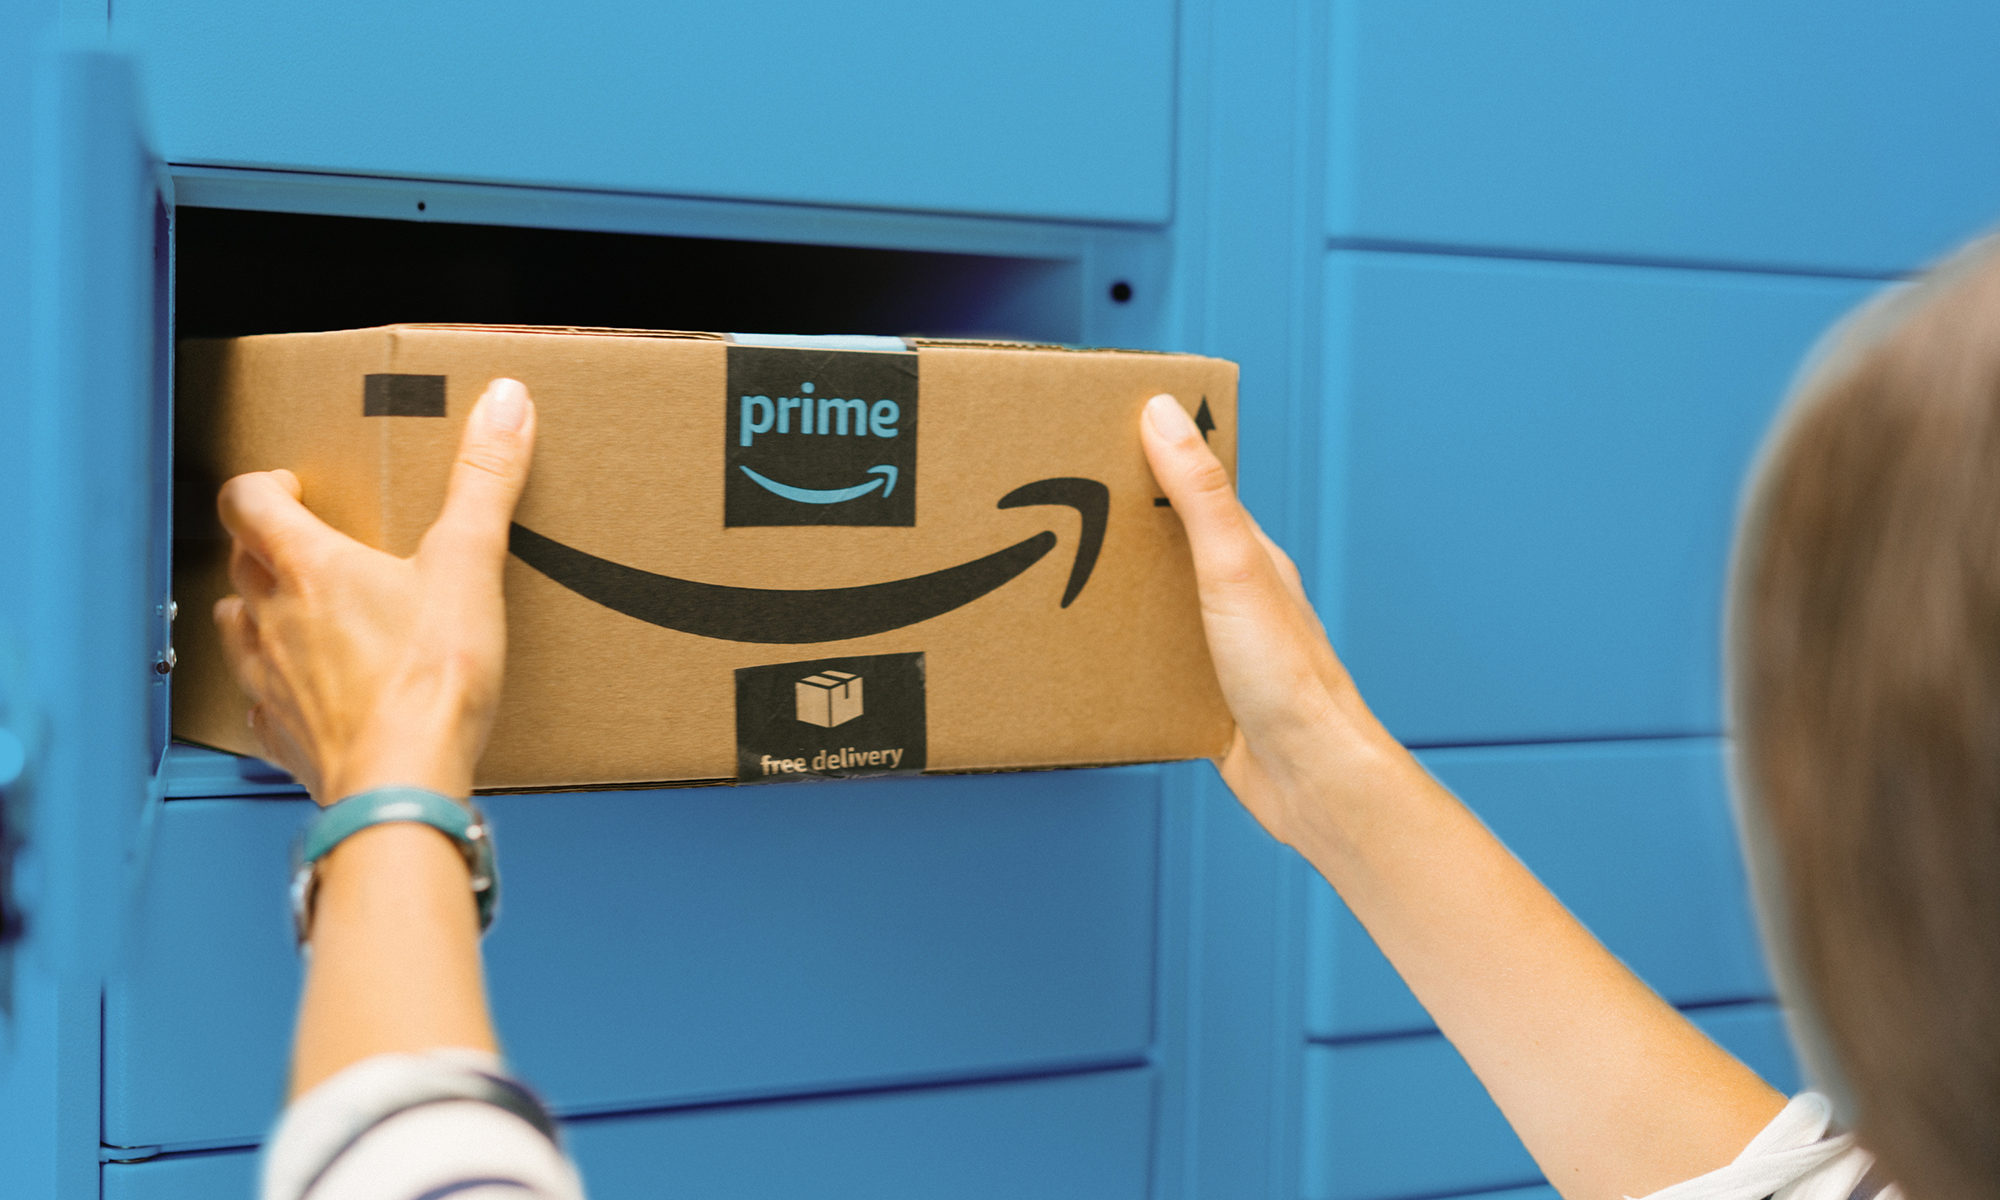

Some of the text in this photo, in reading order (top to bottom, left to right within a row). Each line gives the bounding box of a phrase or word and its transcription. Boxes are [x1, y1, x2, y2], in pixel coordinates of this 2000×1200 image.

[740, 382, 900, 447] prime
[760, 747, 903, 776] free delivery
